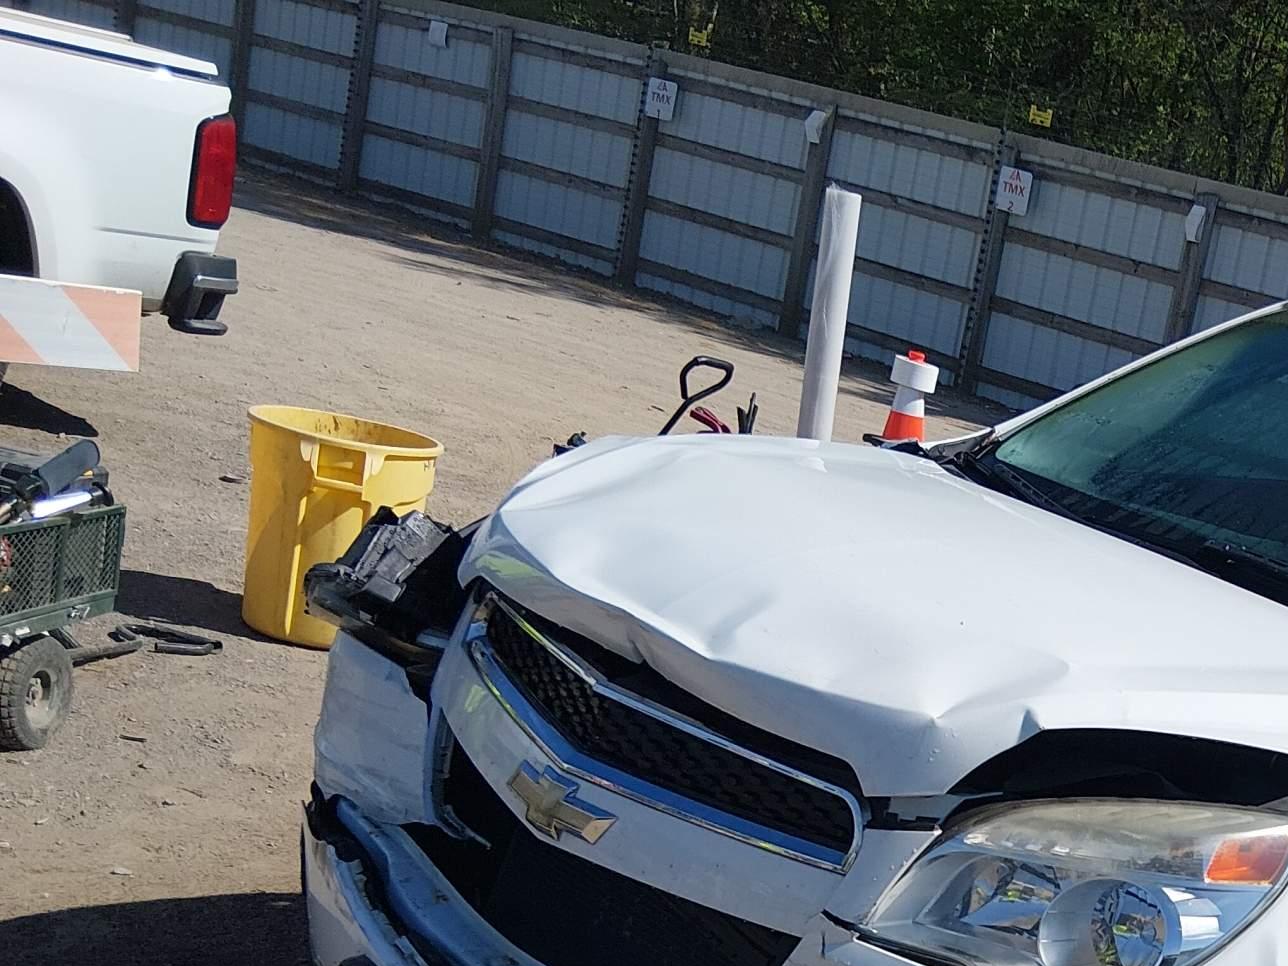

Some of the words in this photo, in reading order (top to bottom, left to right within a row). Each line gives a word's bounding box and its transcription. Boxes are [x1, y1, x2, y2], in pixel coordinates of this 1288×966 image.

[652, 91, 672, 105] TMX
[1003, 181, 1026, 198] TMX
[1007, 200, 1015, 212] 2
